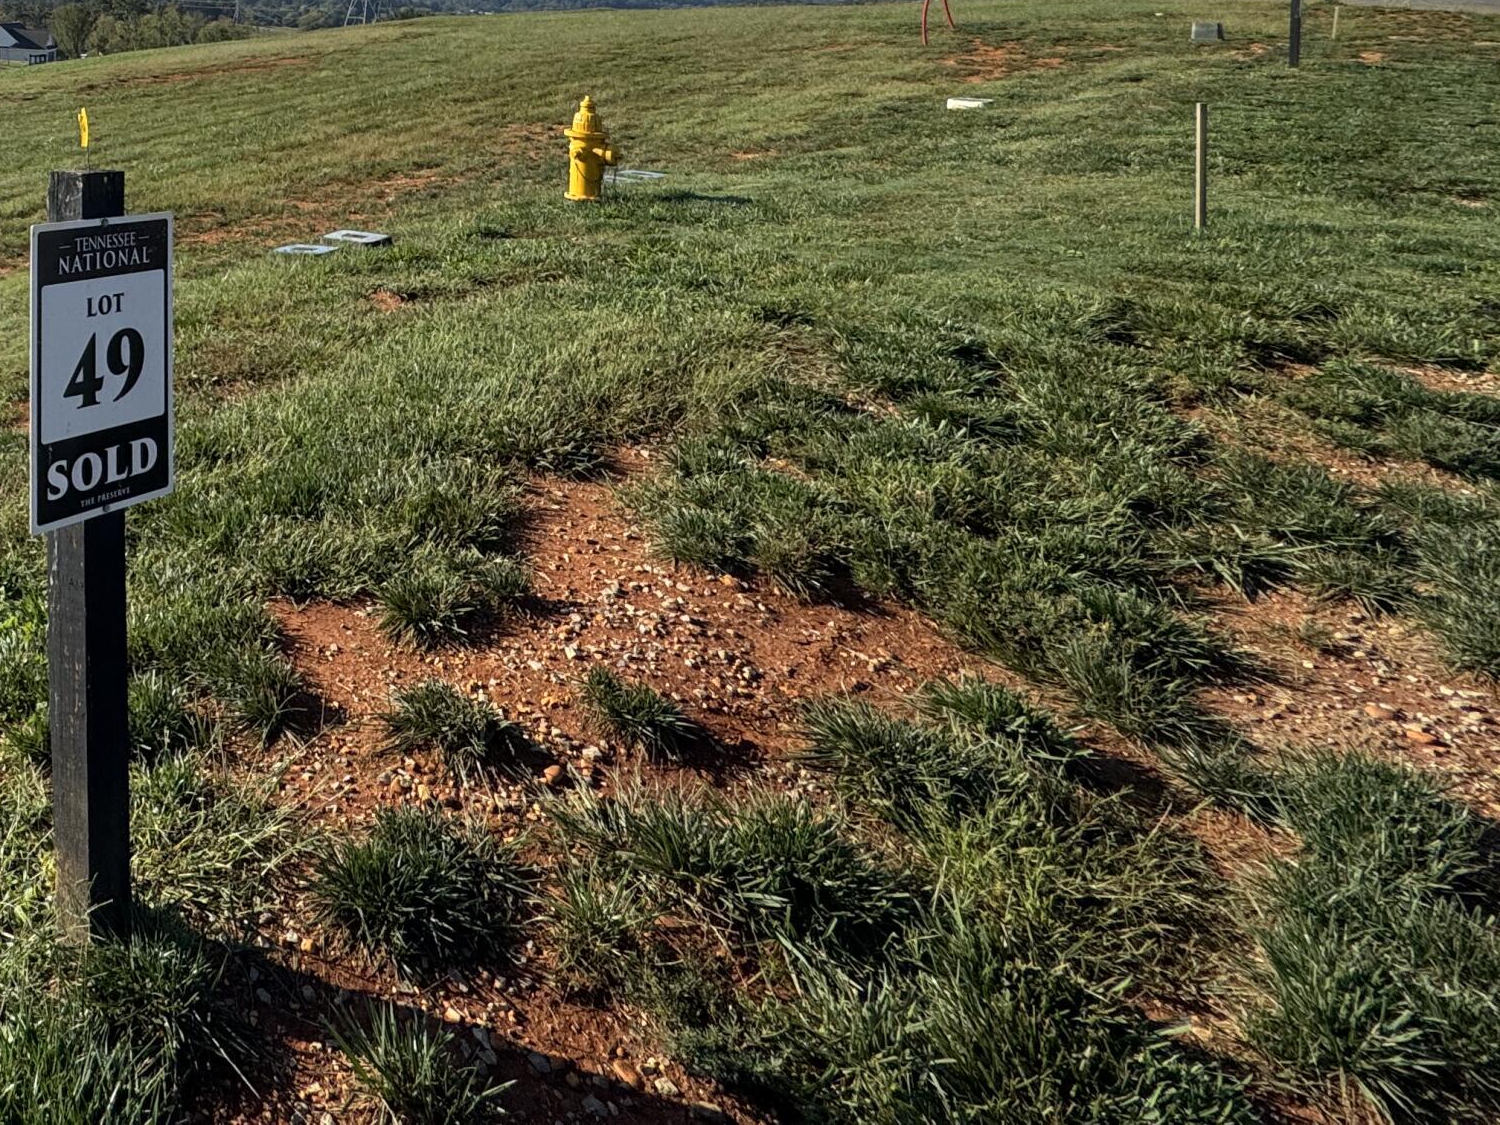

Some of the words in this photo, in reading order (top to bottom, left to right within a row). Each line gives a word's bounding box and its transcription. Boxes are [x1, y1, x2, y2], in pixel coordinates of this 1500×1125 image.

[75, 232, 136, 252] TENNESSEE
[58, 246, 150, 275] NATIONAL
[86, 292, 124, 317] LOT
[63, 327, 145, 410] 49
[47, 437, 158, 501] SOLD
[80, 496, 95, 508] THE
